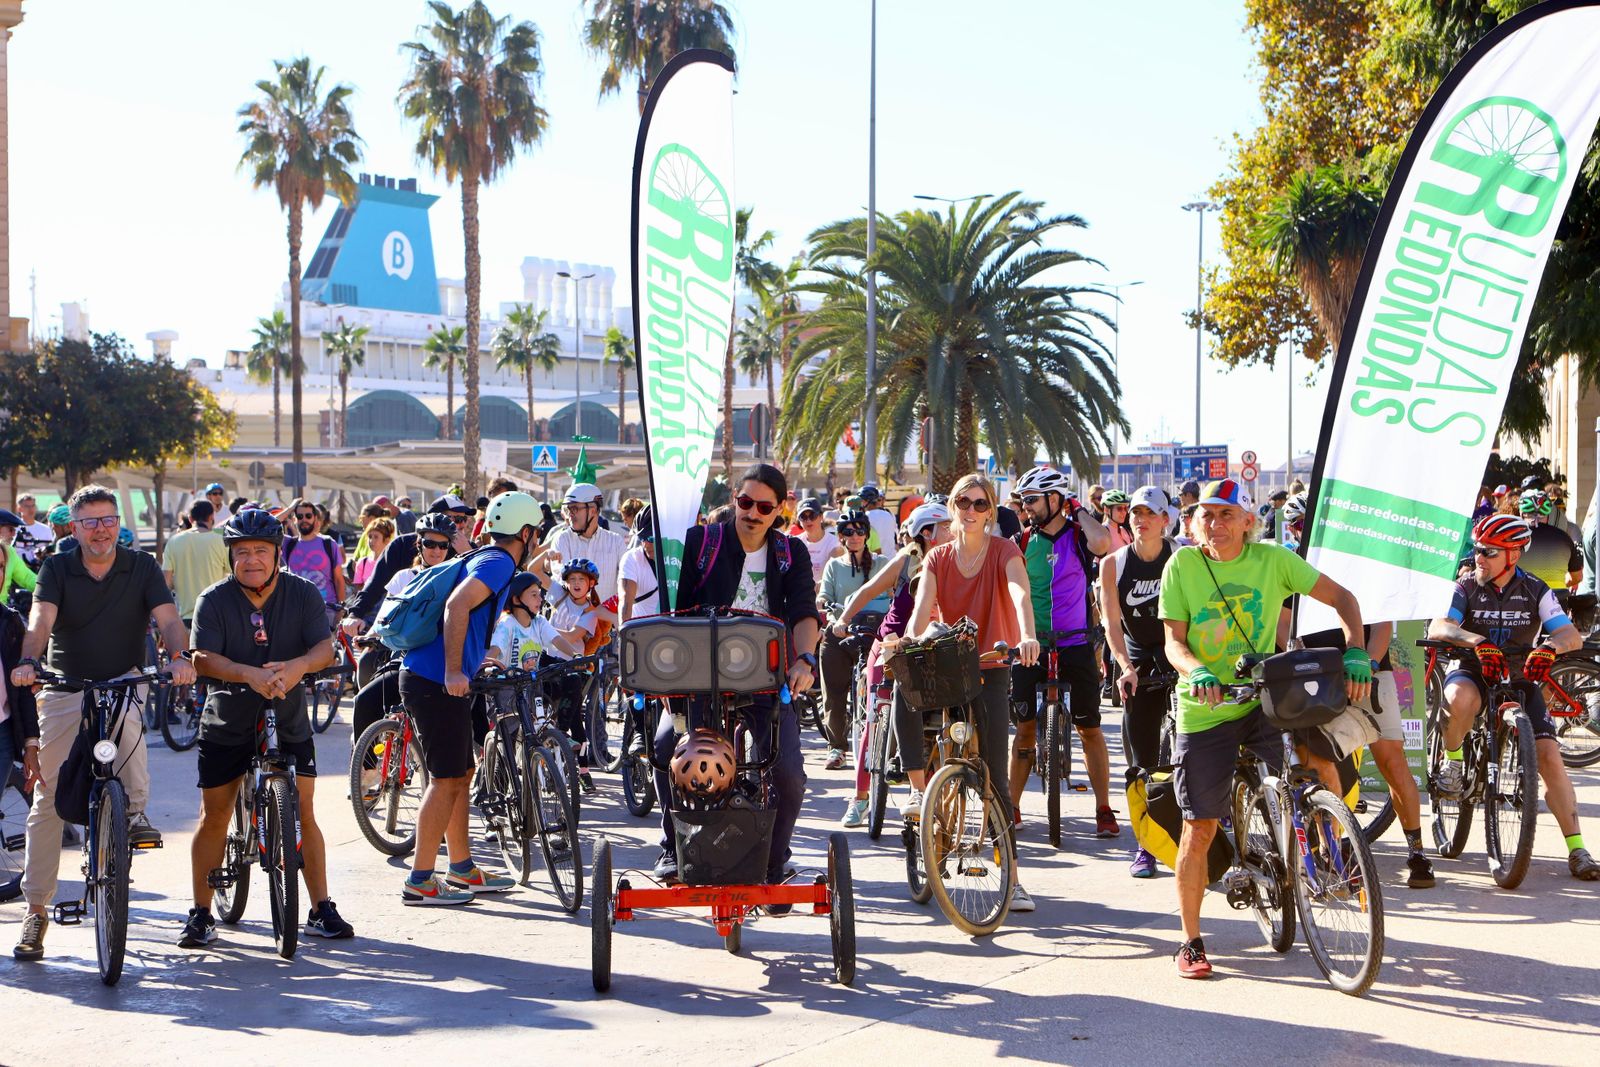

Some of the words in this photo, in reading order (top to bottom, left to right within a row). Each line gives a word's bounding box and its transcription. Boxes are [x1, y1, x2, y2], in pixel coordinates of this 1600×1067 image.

[392, 237, 405, 269] B
[1350, 140, 1492, 426] REDONDAS
[1323, 496, 1461, 541] ruedasredondas.org
[1132, 579, 1160, 594] NIK
[1471, 609, 1531, 619] TREK
